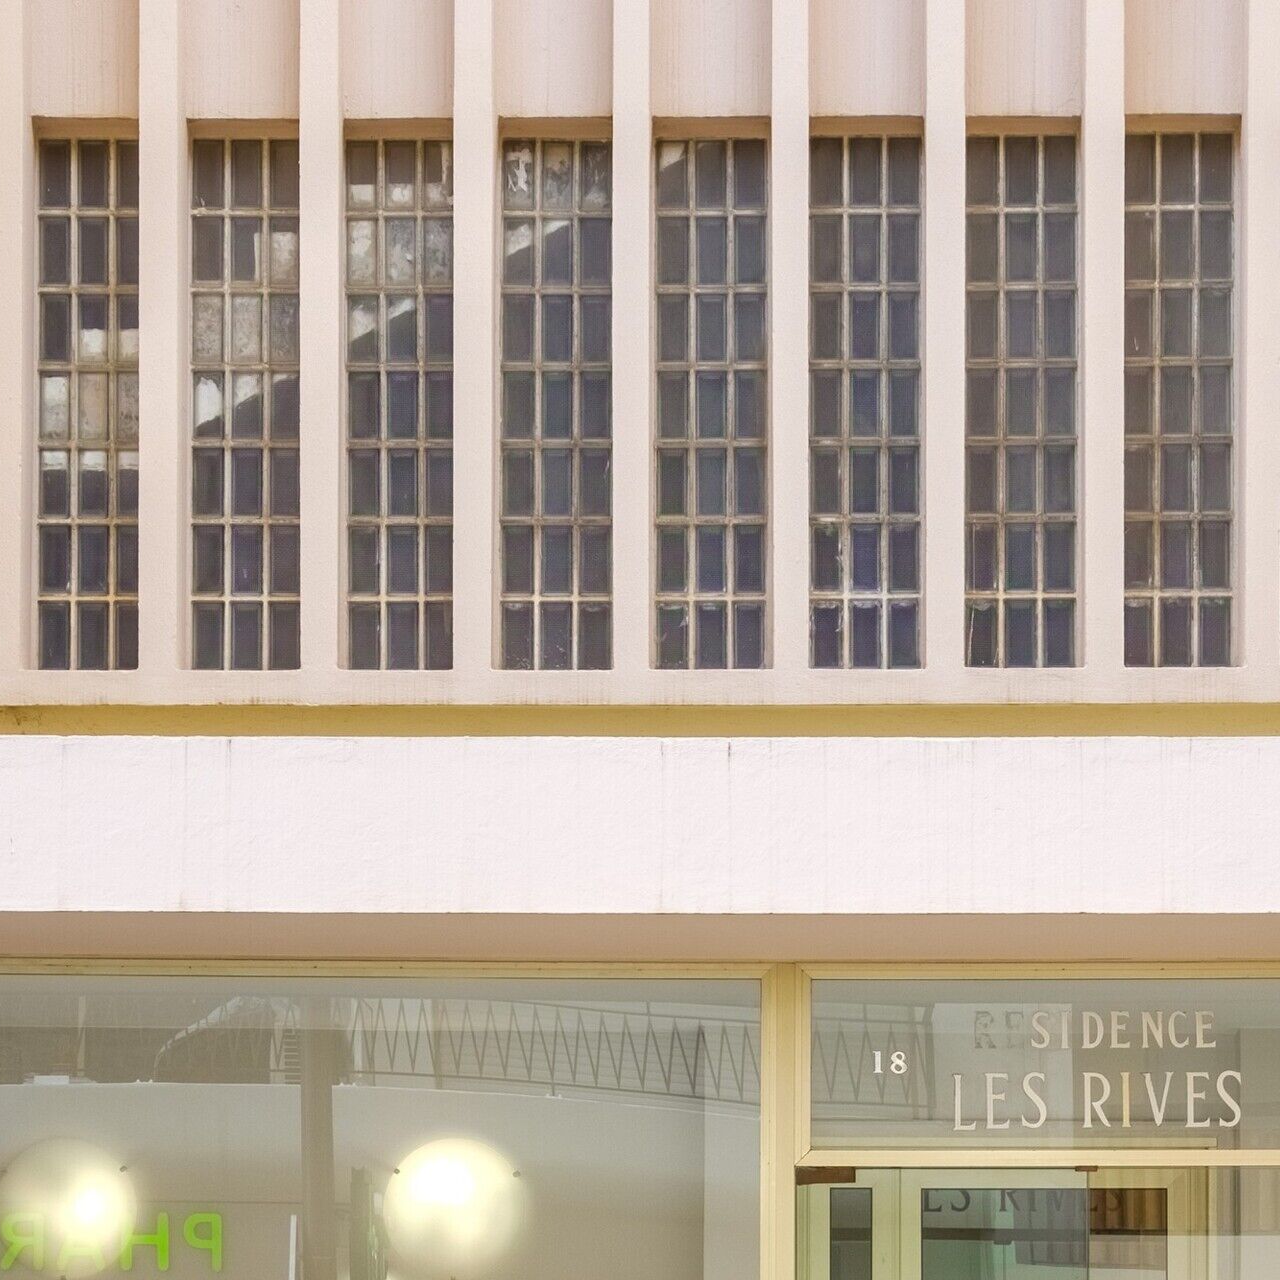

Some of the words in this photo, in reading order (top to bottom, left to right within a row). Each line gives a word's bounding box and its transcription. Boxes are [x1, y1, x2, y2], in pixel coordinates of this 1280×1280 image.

[973, 1010, 1217, 1050] RESIDENCE
[872, 1050, 908, 1074] 18
[953, 1071, 1048, 1131] LES
[1082, 1070, 1242, 1129] RIVES
